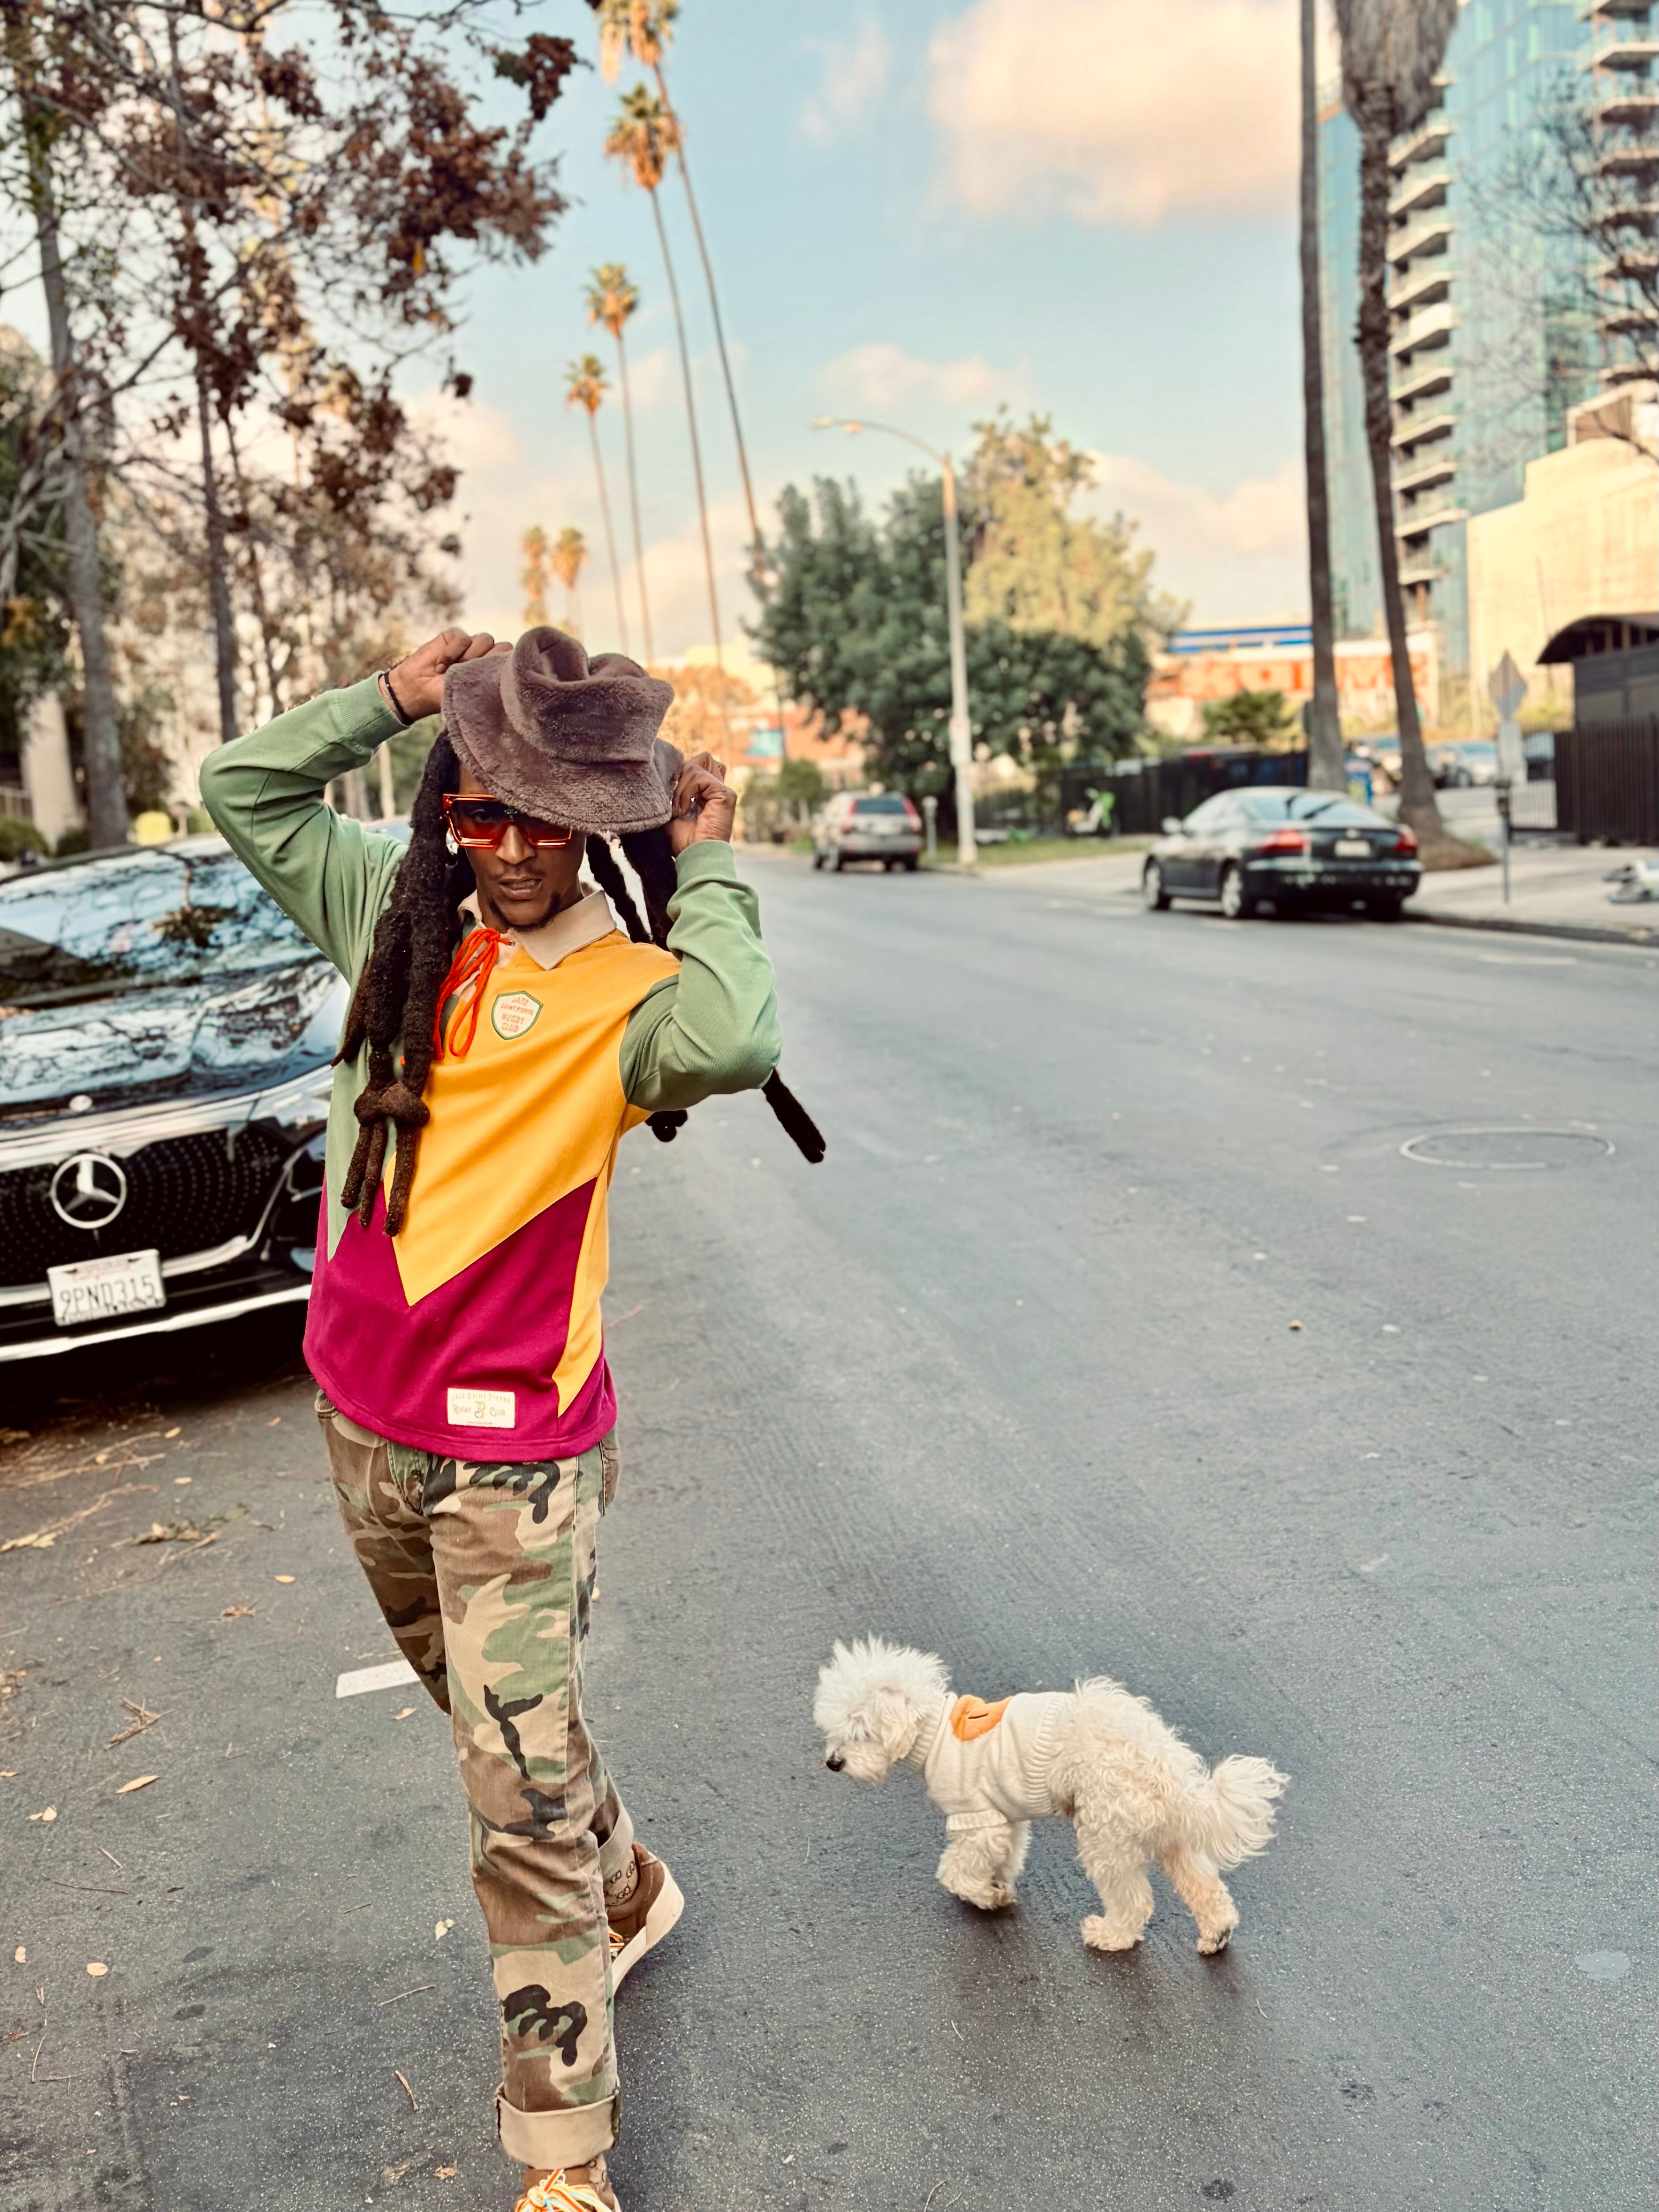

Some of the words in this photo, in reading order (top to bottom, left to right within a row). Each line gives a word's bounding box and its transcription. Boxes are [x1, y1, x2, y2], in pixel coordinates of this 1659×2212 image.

[512, 997, 529, 1006] JAZZ
[502, 1014, 525, 1024] RUGBY
[501, 1023, 519, 1032] CLUB
